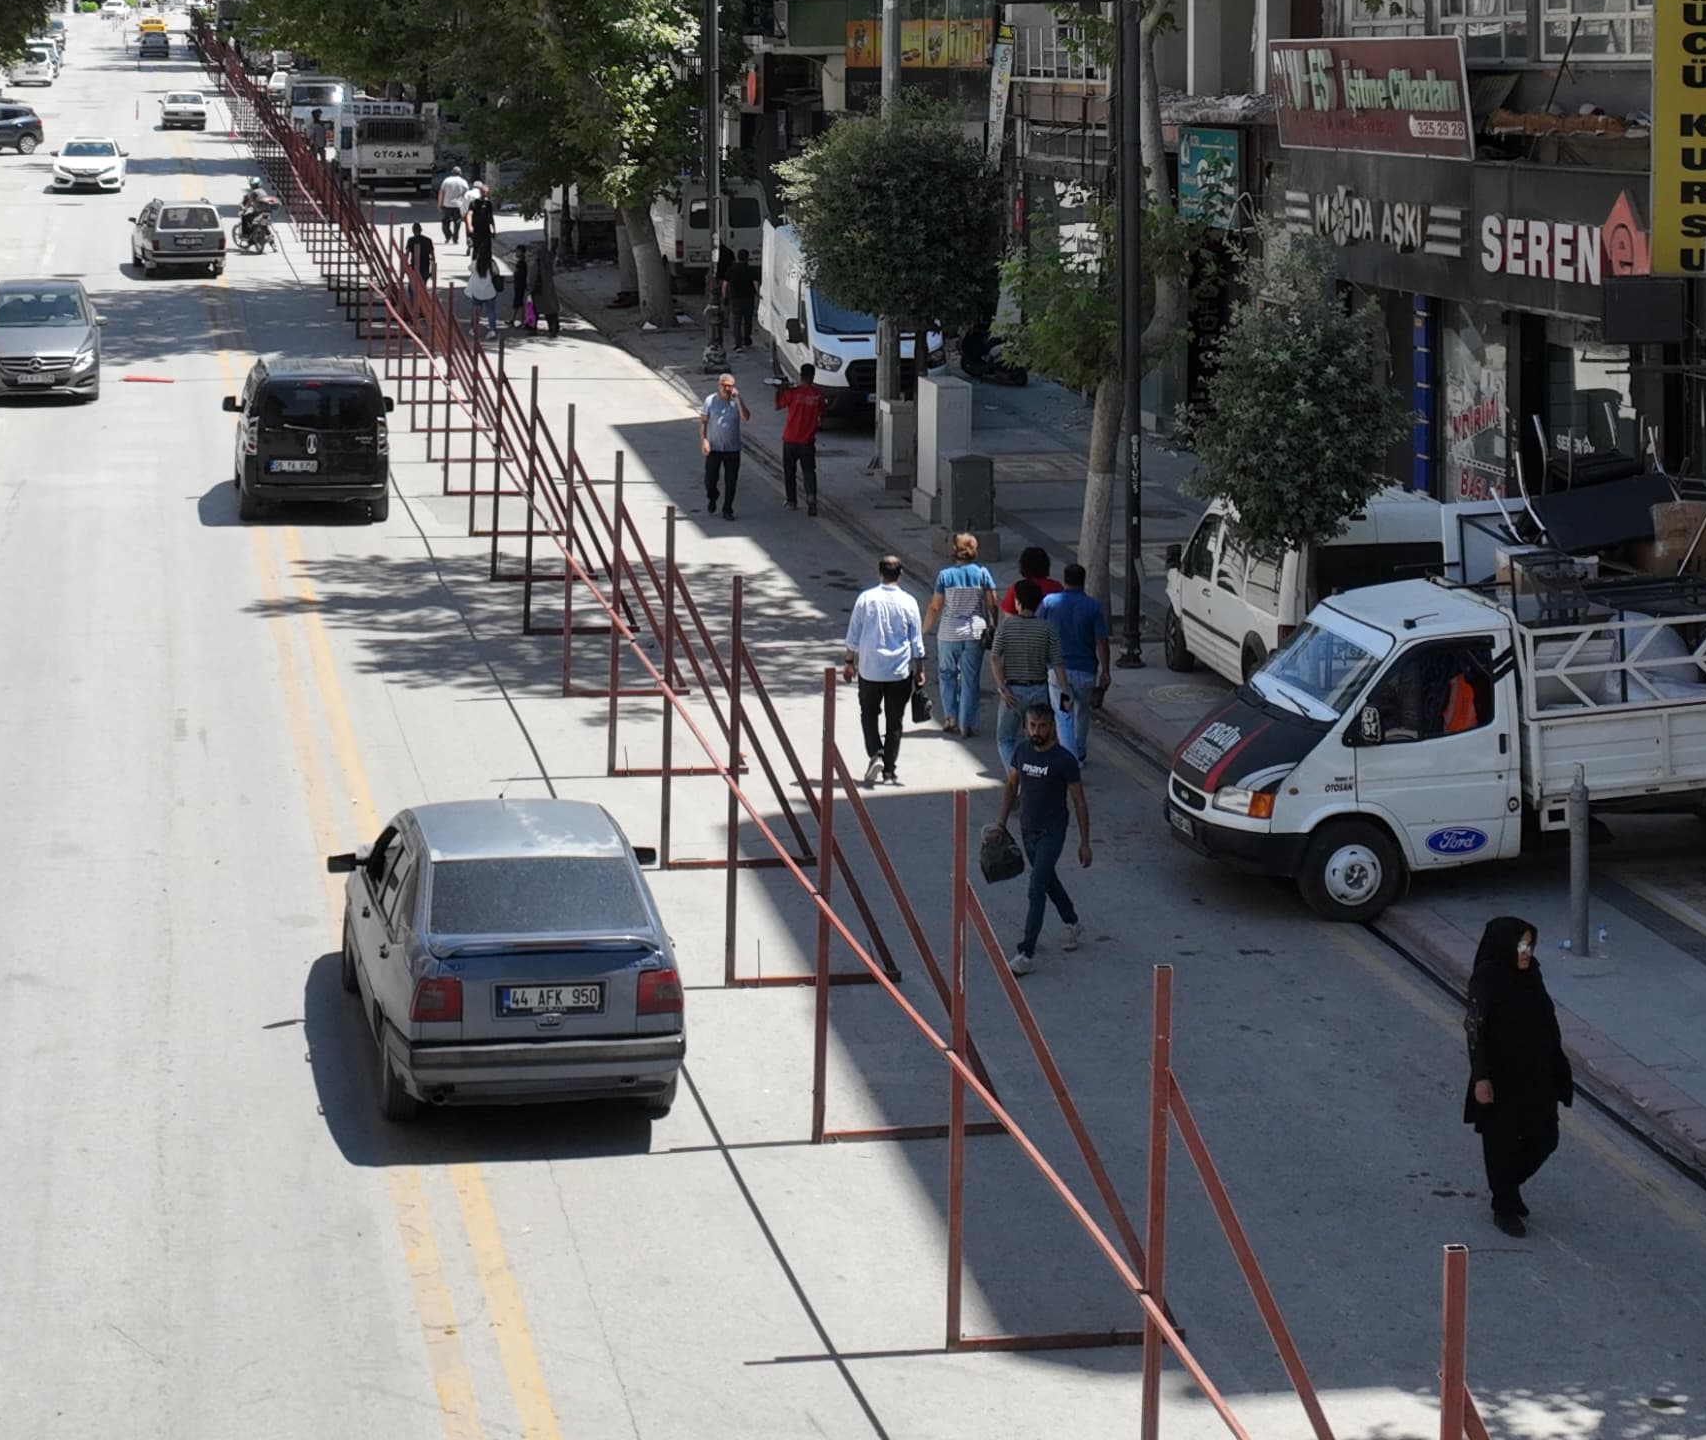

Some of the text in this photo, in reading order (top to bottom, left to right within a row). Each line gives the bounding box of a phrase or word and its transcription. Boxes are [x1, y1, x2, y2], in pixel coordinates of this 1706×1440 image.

[1417, 122, 1464, 137] 325 29 28
[1381, 203, 1423, 254] AŞKI
[1481, 215, 1602, 286] SEREN
[1439, 830, 1476, 850] Ford
[511, 988, 598, 1007] 44 AFK 950
